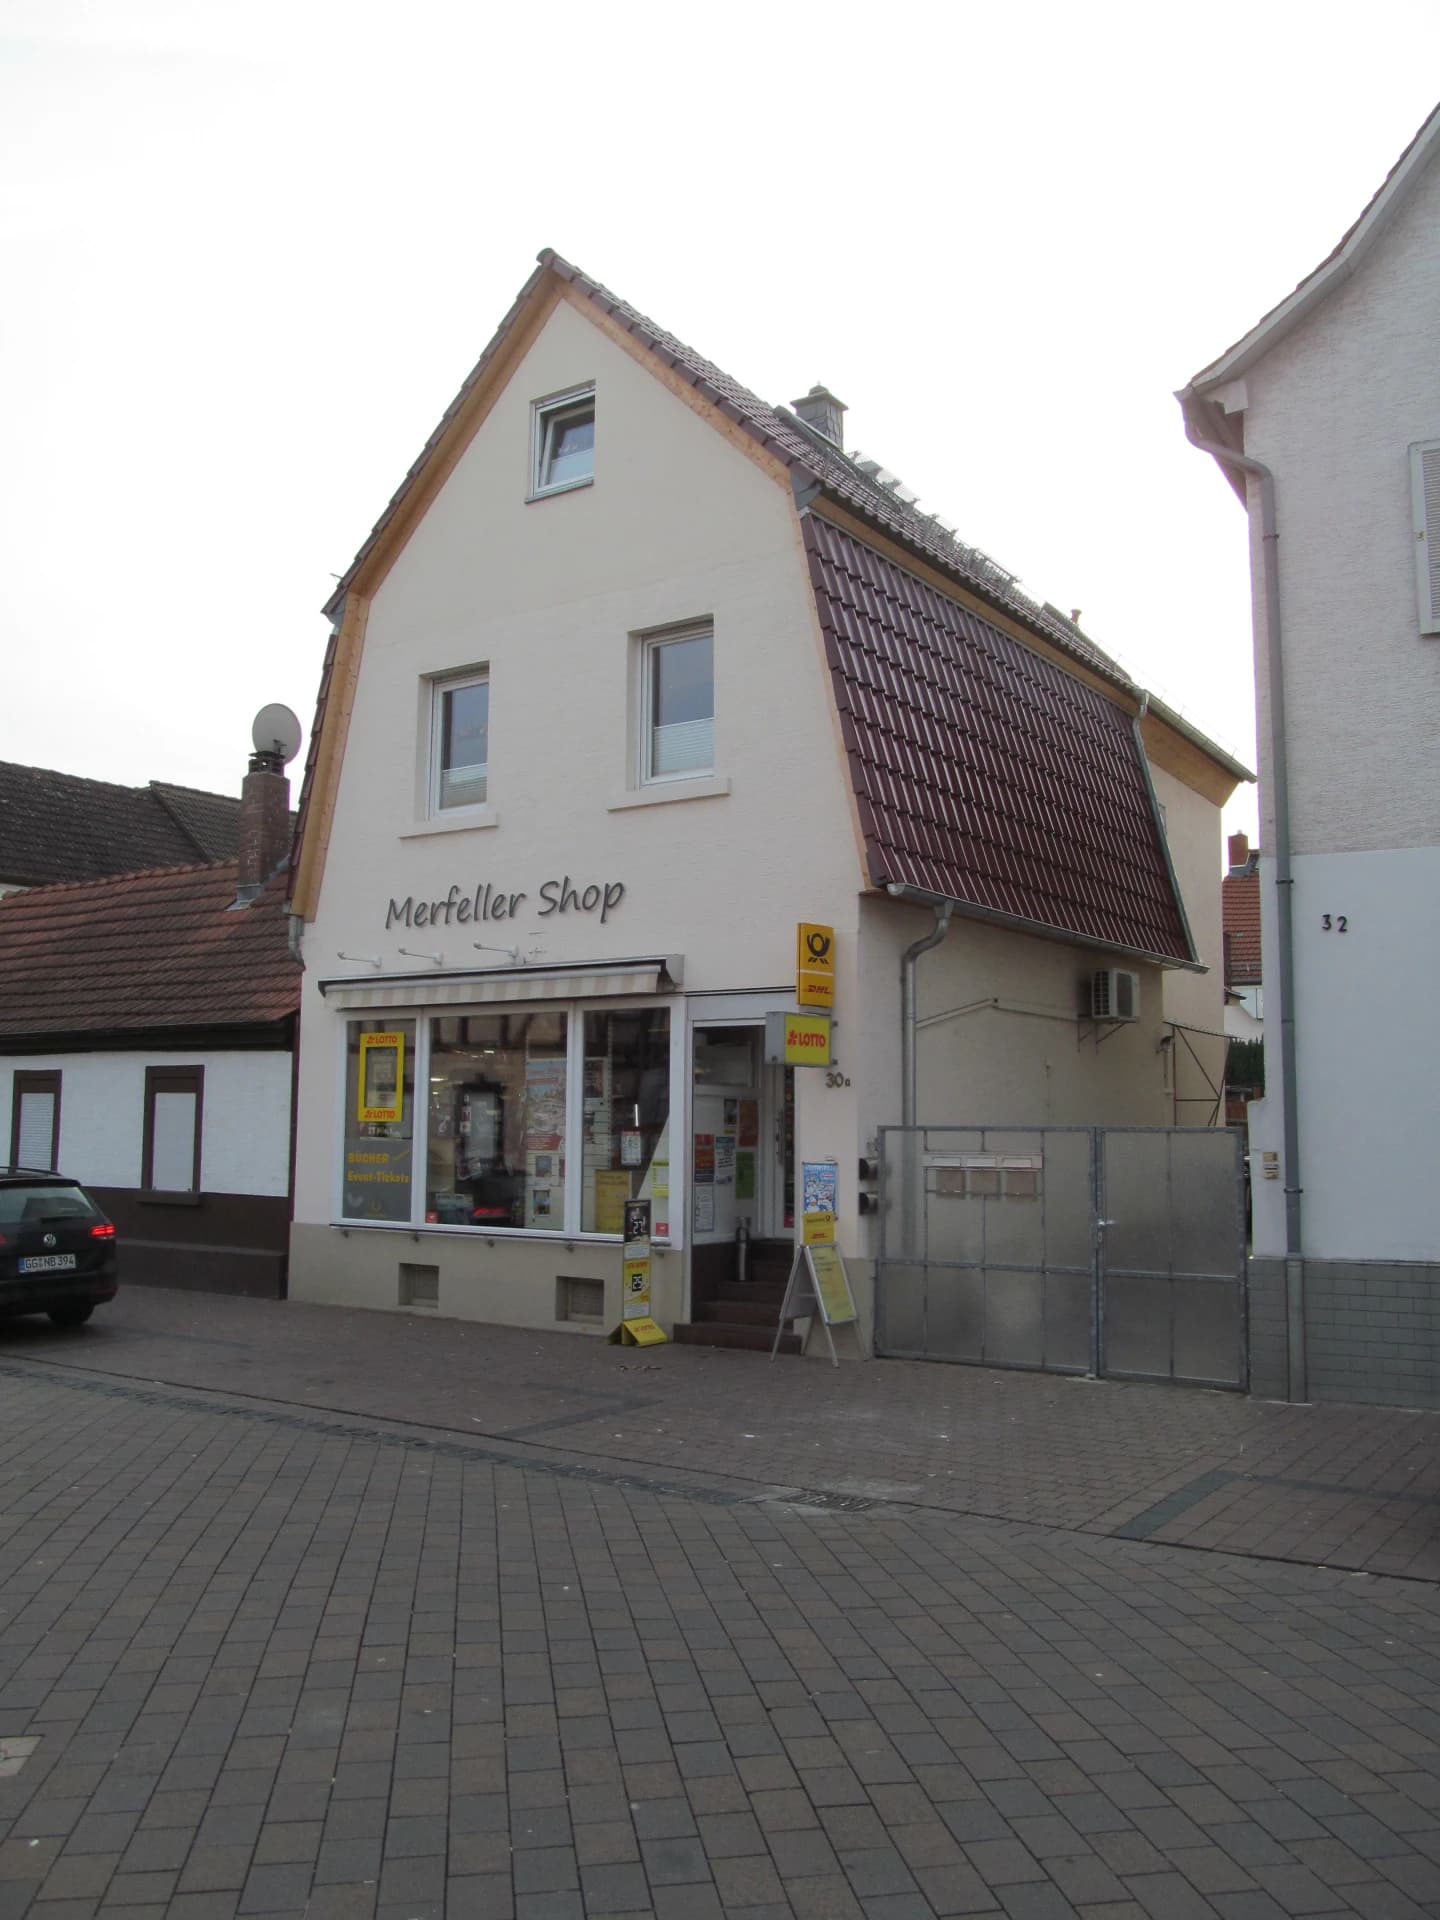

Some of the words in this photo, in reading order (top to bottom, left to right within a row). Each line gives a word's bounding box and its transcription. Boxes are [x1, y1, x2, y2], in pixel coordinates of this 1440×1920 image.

[385, 882, 527, 930] Merfeller
[537, 875, 625, 924] Shop
[1321, 913, 1348, 932] 32
[807, 984, 830, 994] DHL
[375, 1035, 398, 1044] LOTTO
[800, 1033, 826, 1048] LOTTO
[373, 1110, 396, 1119] LOTTO
[57, 1255, 74, 1266] 394
